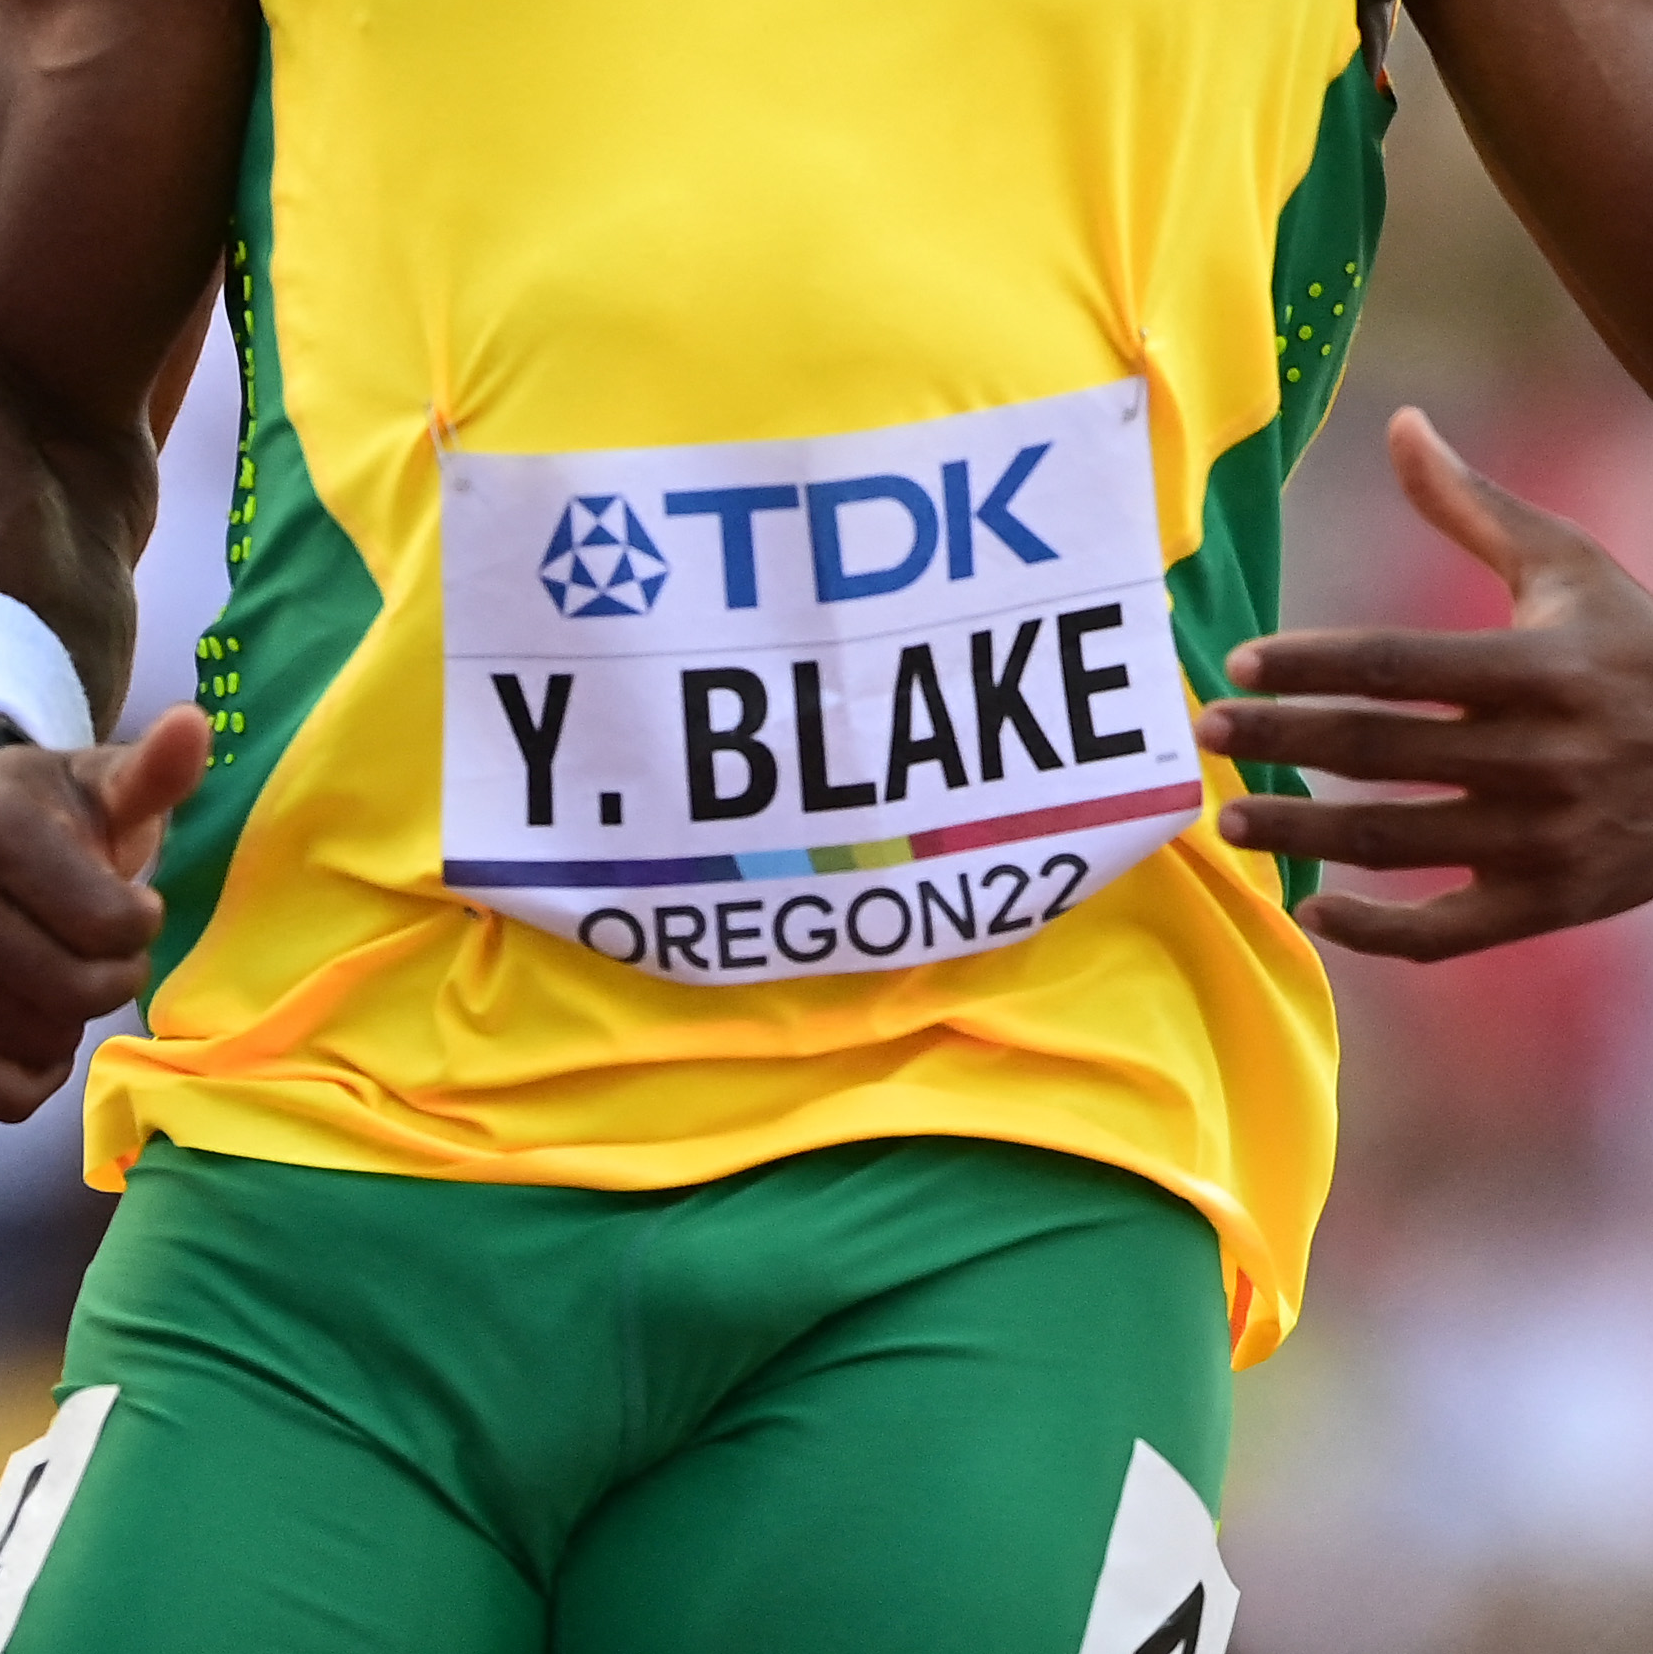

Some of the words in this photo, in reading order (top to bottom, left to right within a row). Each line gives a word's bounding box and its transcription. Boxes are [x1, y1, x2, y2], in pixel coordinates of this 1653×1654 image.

[664, 442, 1060, 611] TDK
[491, 673, 623, 828] Y.
[680, 603, 1148, 824] BLAKE
[577, 853, 1090, 972] OREGON22
